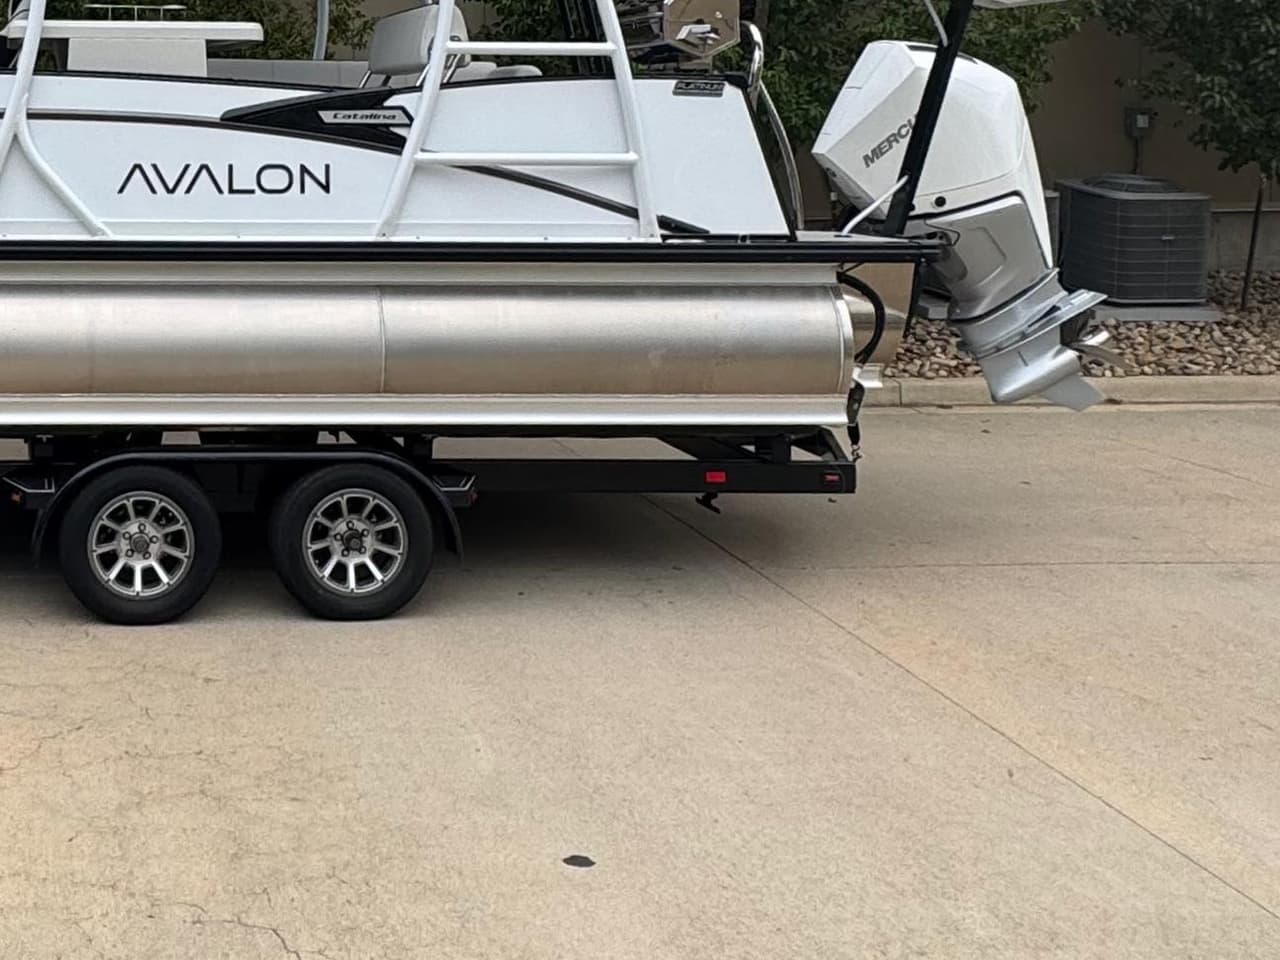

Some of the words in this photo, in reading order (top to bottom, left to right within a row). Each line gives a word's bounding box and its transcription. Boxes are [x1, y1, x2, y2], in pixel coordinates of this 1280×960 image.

[333, 112, 397, 121] Catalina
[862, 115, 916, 168] MERC
[117, 163, 331, 195] AVALON
